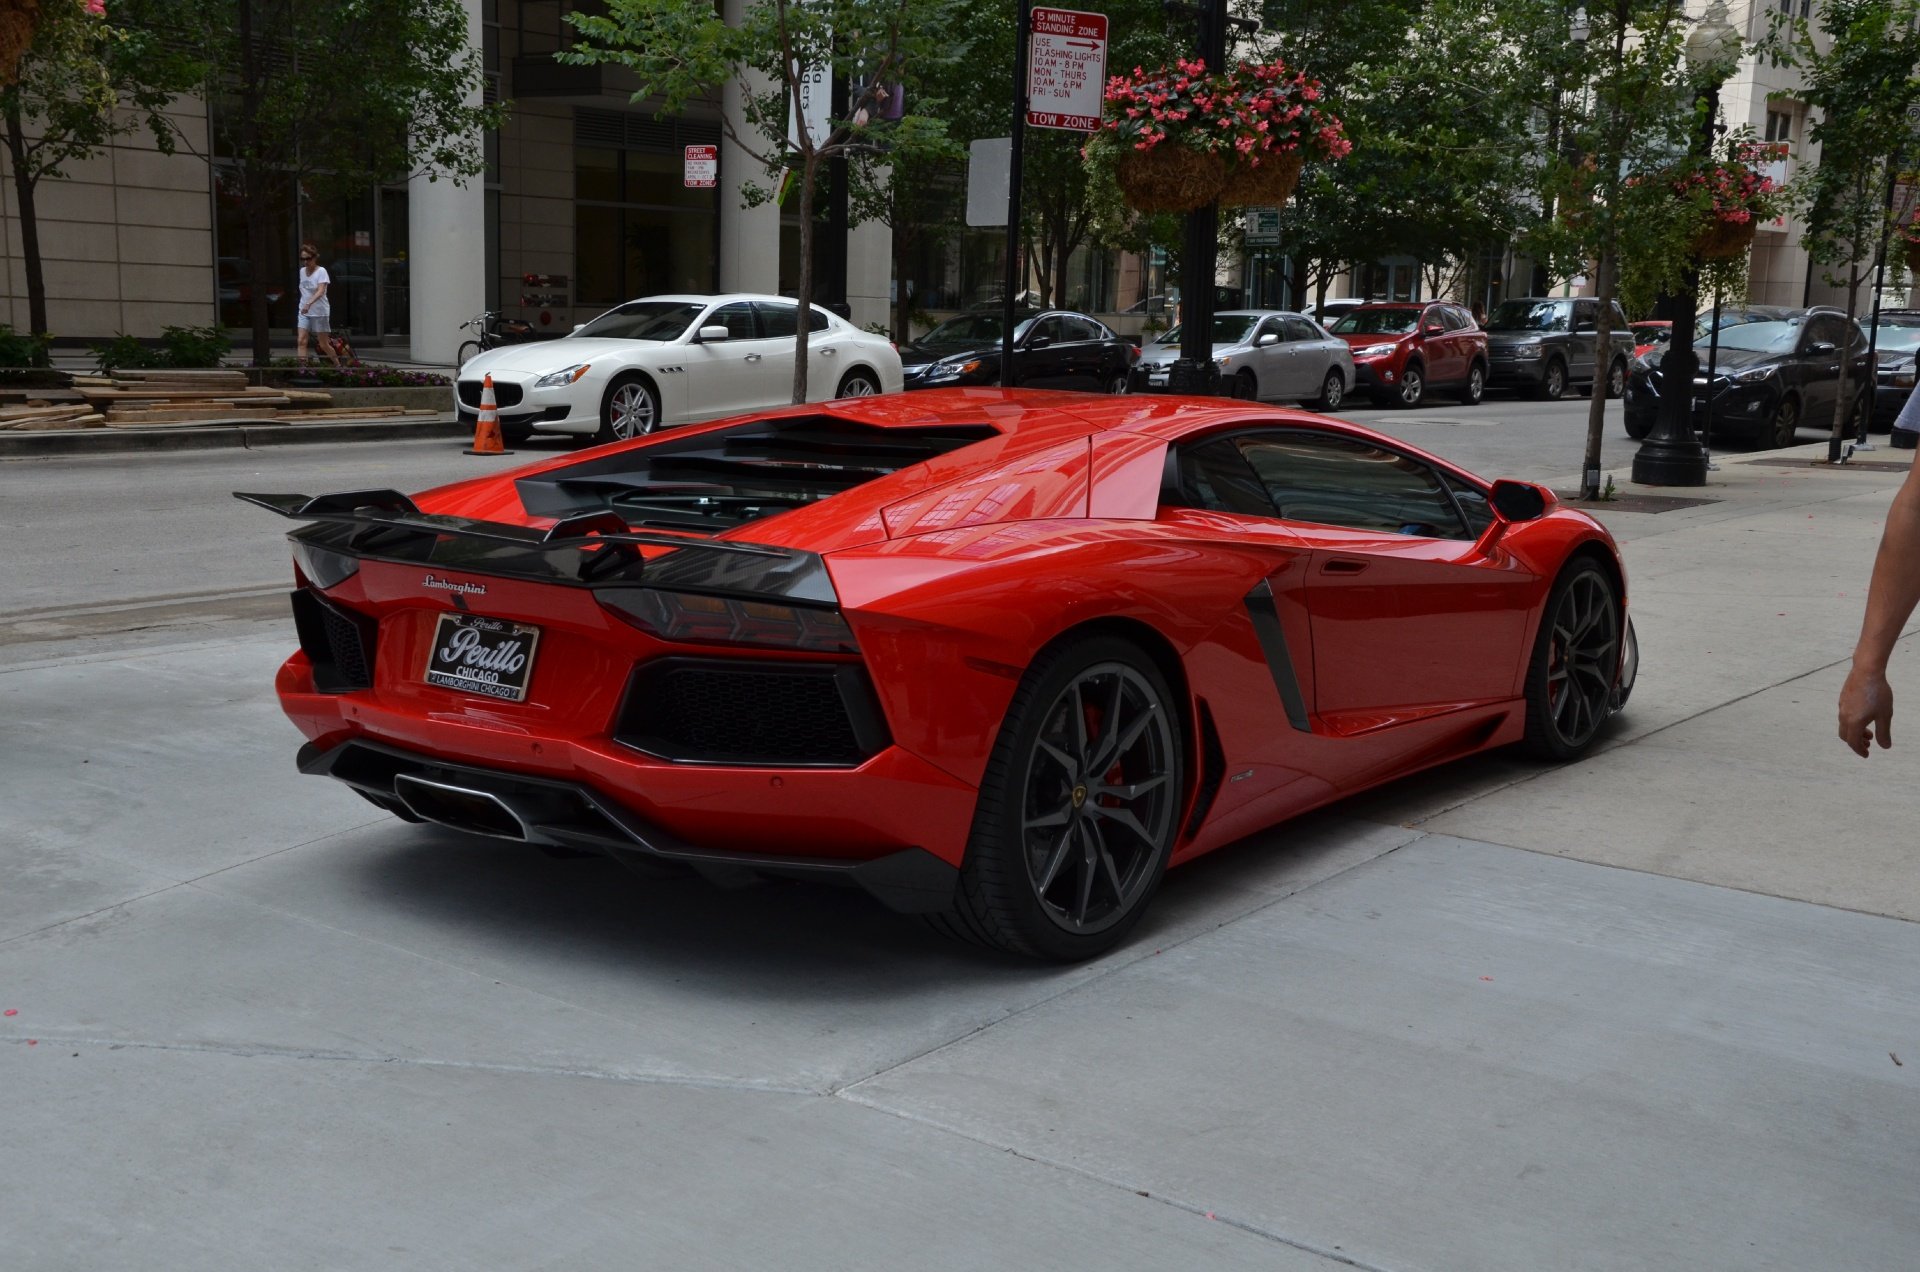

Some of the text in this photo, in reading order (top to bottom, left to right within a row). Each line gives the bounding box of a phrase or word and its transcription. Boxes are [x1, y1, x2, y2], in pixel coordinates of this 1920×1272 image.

[1037, 12, 1076, 24] 15 MINUTE
[1036, 22, 1098, 36] STANDING ZONE
[1036, 38, 1051, 46] USE
[1035, 48, 1100, 62] FLASHING LIGHTS
[1034, 68, 1052, 76] MON
[1060, 70, 1087, 80] THURS
[1032, 86, 1046, 96] FRI
[1054, 88, 1070, 98] SUN
[1032, 112, 1094, 129] TOW ZONE
[422, 574, 486, 594] Lamborghini
[470, 618, 503, 631] Perillo
[440, 628, 525, 674] Perillo
[456, 666, 499, 683] CHICAGO
[437, 677, 509, 697] LAMBORGHINI CHICAGO
